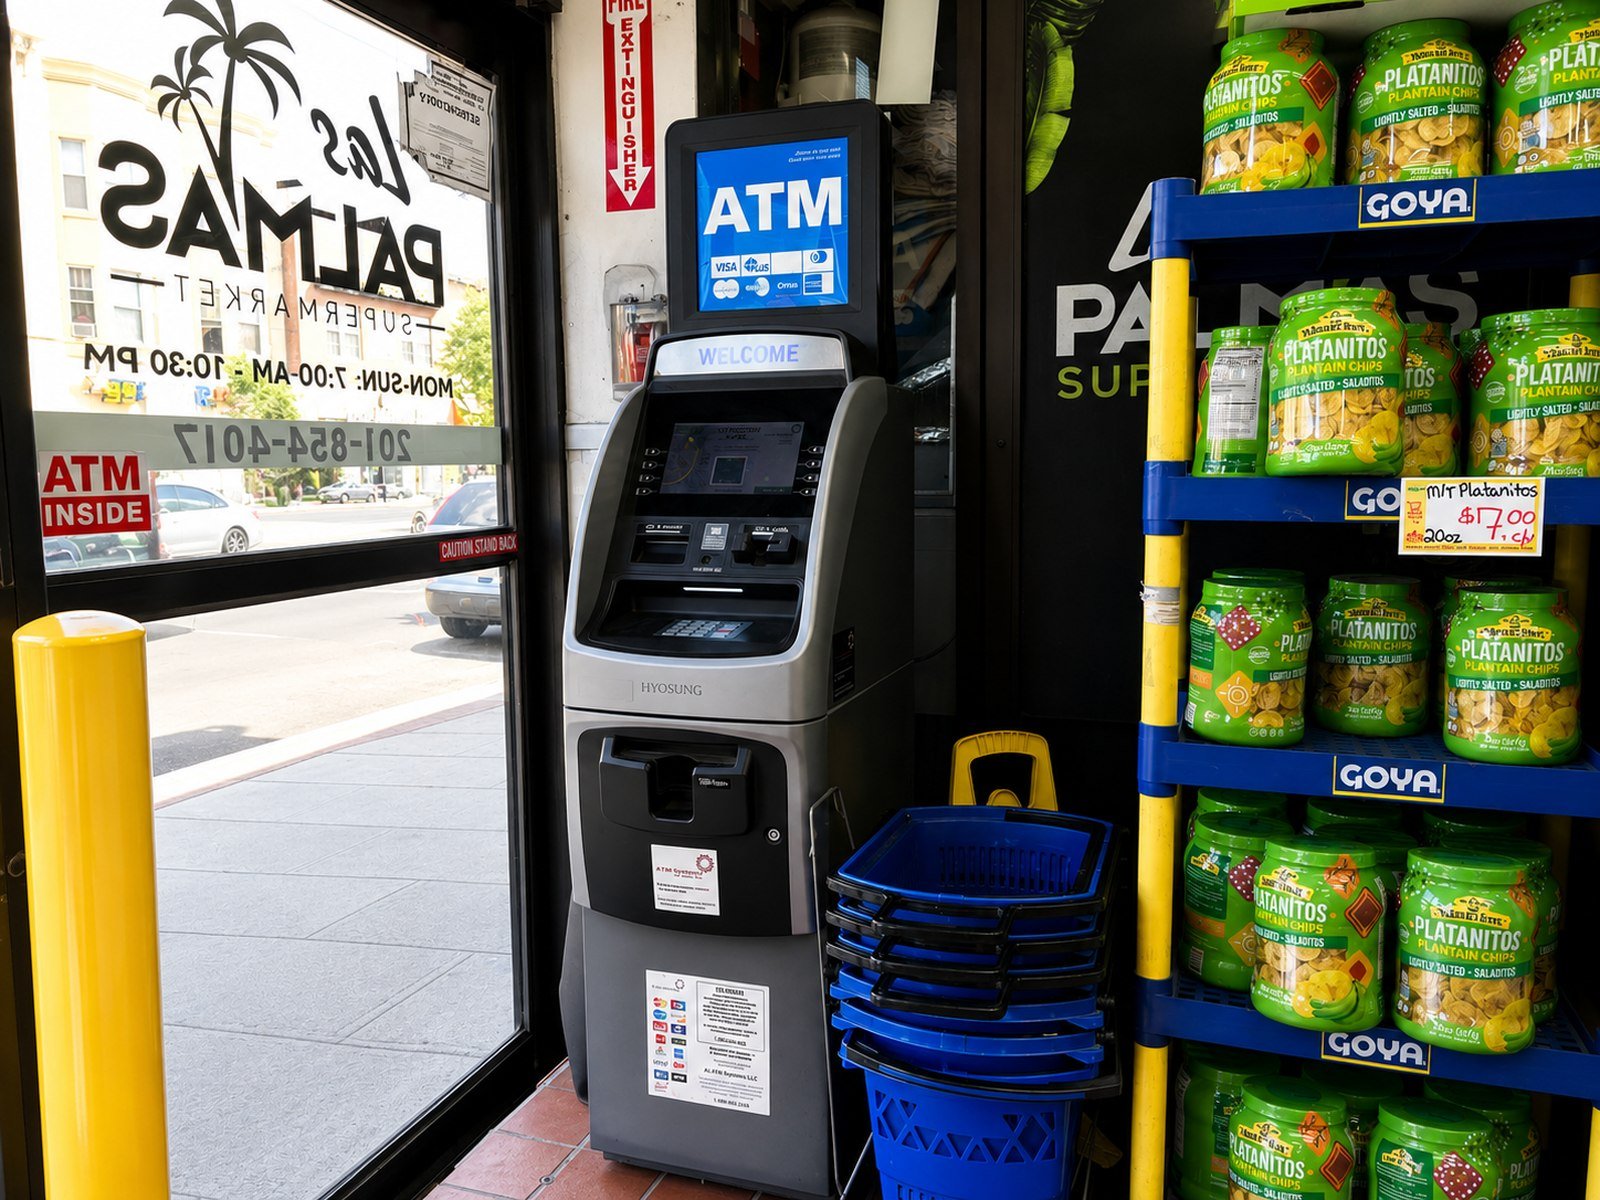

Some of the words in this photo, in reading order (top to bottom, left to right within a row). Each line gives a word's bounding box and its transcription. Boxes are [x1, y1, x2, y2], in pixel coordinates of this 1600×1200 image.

[1385, 63, 1484, 92] PLATANITOS
[1553, 67, 1600, 84] PLANT
[620, 17, 637, 192] EXTINGUISHER
[1388, 86, 1450, 104] PLANTAIN
[1576, 88, 1600, 100] SALTE
[1375, 112, 1406, 128] LIGHTLY
[1408, 105, 1438, 119] SALTED
[703, 177, 842, 235] ATM
[1366, 187, 1468, 220] GOYA
[715, 262, 737, 272] VISA
[699, 344, 799, 365] WELCOME
[1284, 337, 1387, 366] PLATANITOS
[1288, 362, 1346, 376] PLANTAIN
[1349, 361, 1383, 372] CHIPS
[1516, 362, 1600, 387] PLATANIT
[1405, 389, 1431, 400] HIPS
[1521, 385, 1582, 398] PLANTAIN
[1542, 404, 1572, 416] SALTED
[43, 455, 140, 493] ATM
[1352, 487, 1400, 513] GO
[1460, 482, 1538, 499] Platanitos
[45, 501, 143, 527] INSIDE
[441, 540, 473, 558] CAUTION
[475, 537, 497, 554] STAND
[498, 535, 517, 551] BACK
[1423, 528, 1462, 543] 20oz
[1331, 619, 1417, 640] PLATANITOS
[1462, 639, 1565, 663] PLATANITOS
[1465, 660, 1524, 673] PLANTAIN
[1527, 663, 1560, 674] CHIPS
[641, 682, 702, 696] HYOSUNG
[1482, 679, 1511, 691] SALTED
[1340, 764, 1438, 793] GOYA
[1254, 883, 1328, 923] LATANITOS
[1289, 920, 1323, 934] CHIPS
[1415, 915, 1521, 951] PLATANITOS
[1418, 938, 1478, 960] PLANTAIN
[1481, 952, 1515, 962] CHIPS
[1328, 1032, 1423, 1066] GOYA
[1229, 1131, 1305, 1179] PLATANITOS
[1269, 1175, 1300, 1190] CHIPS
